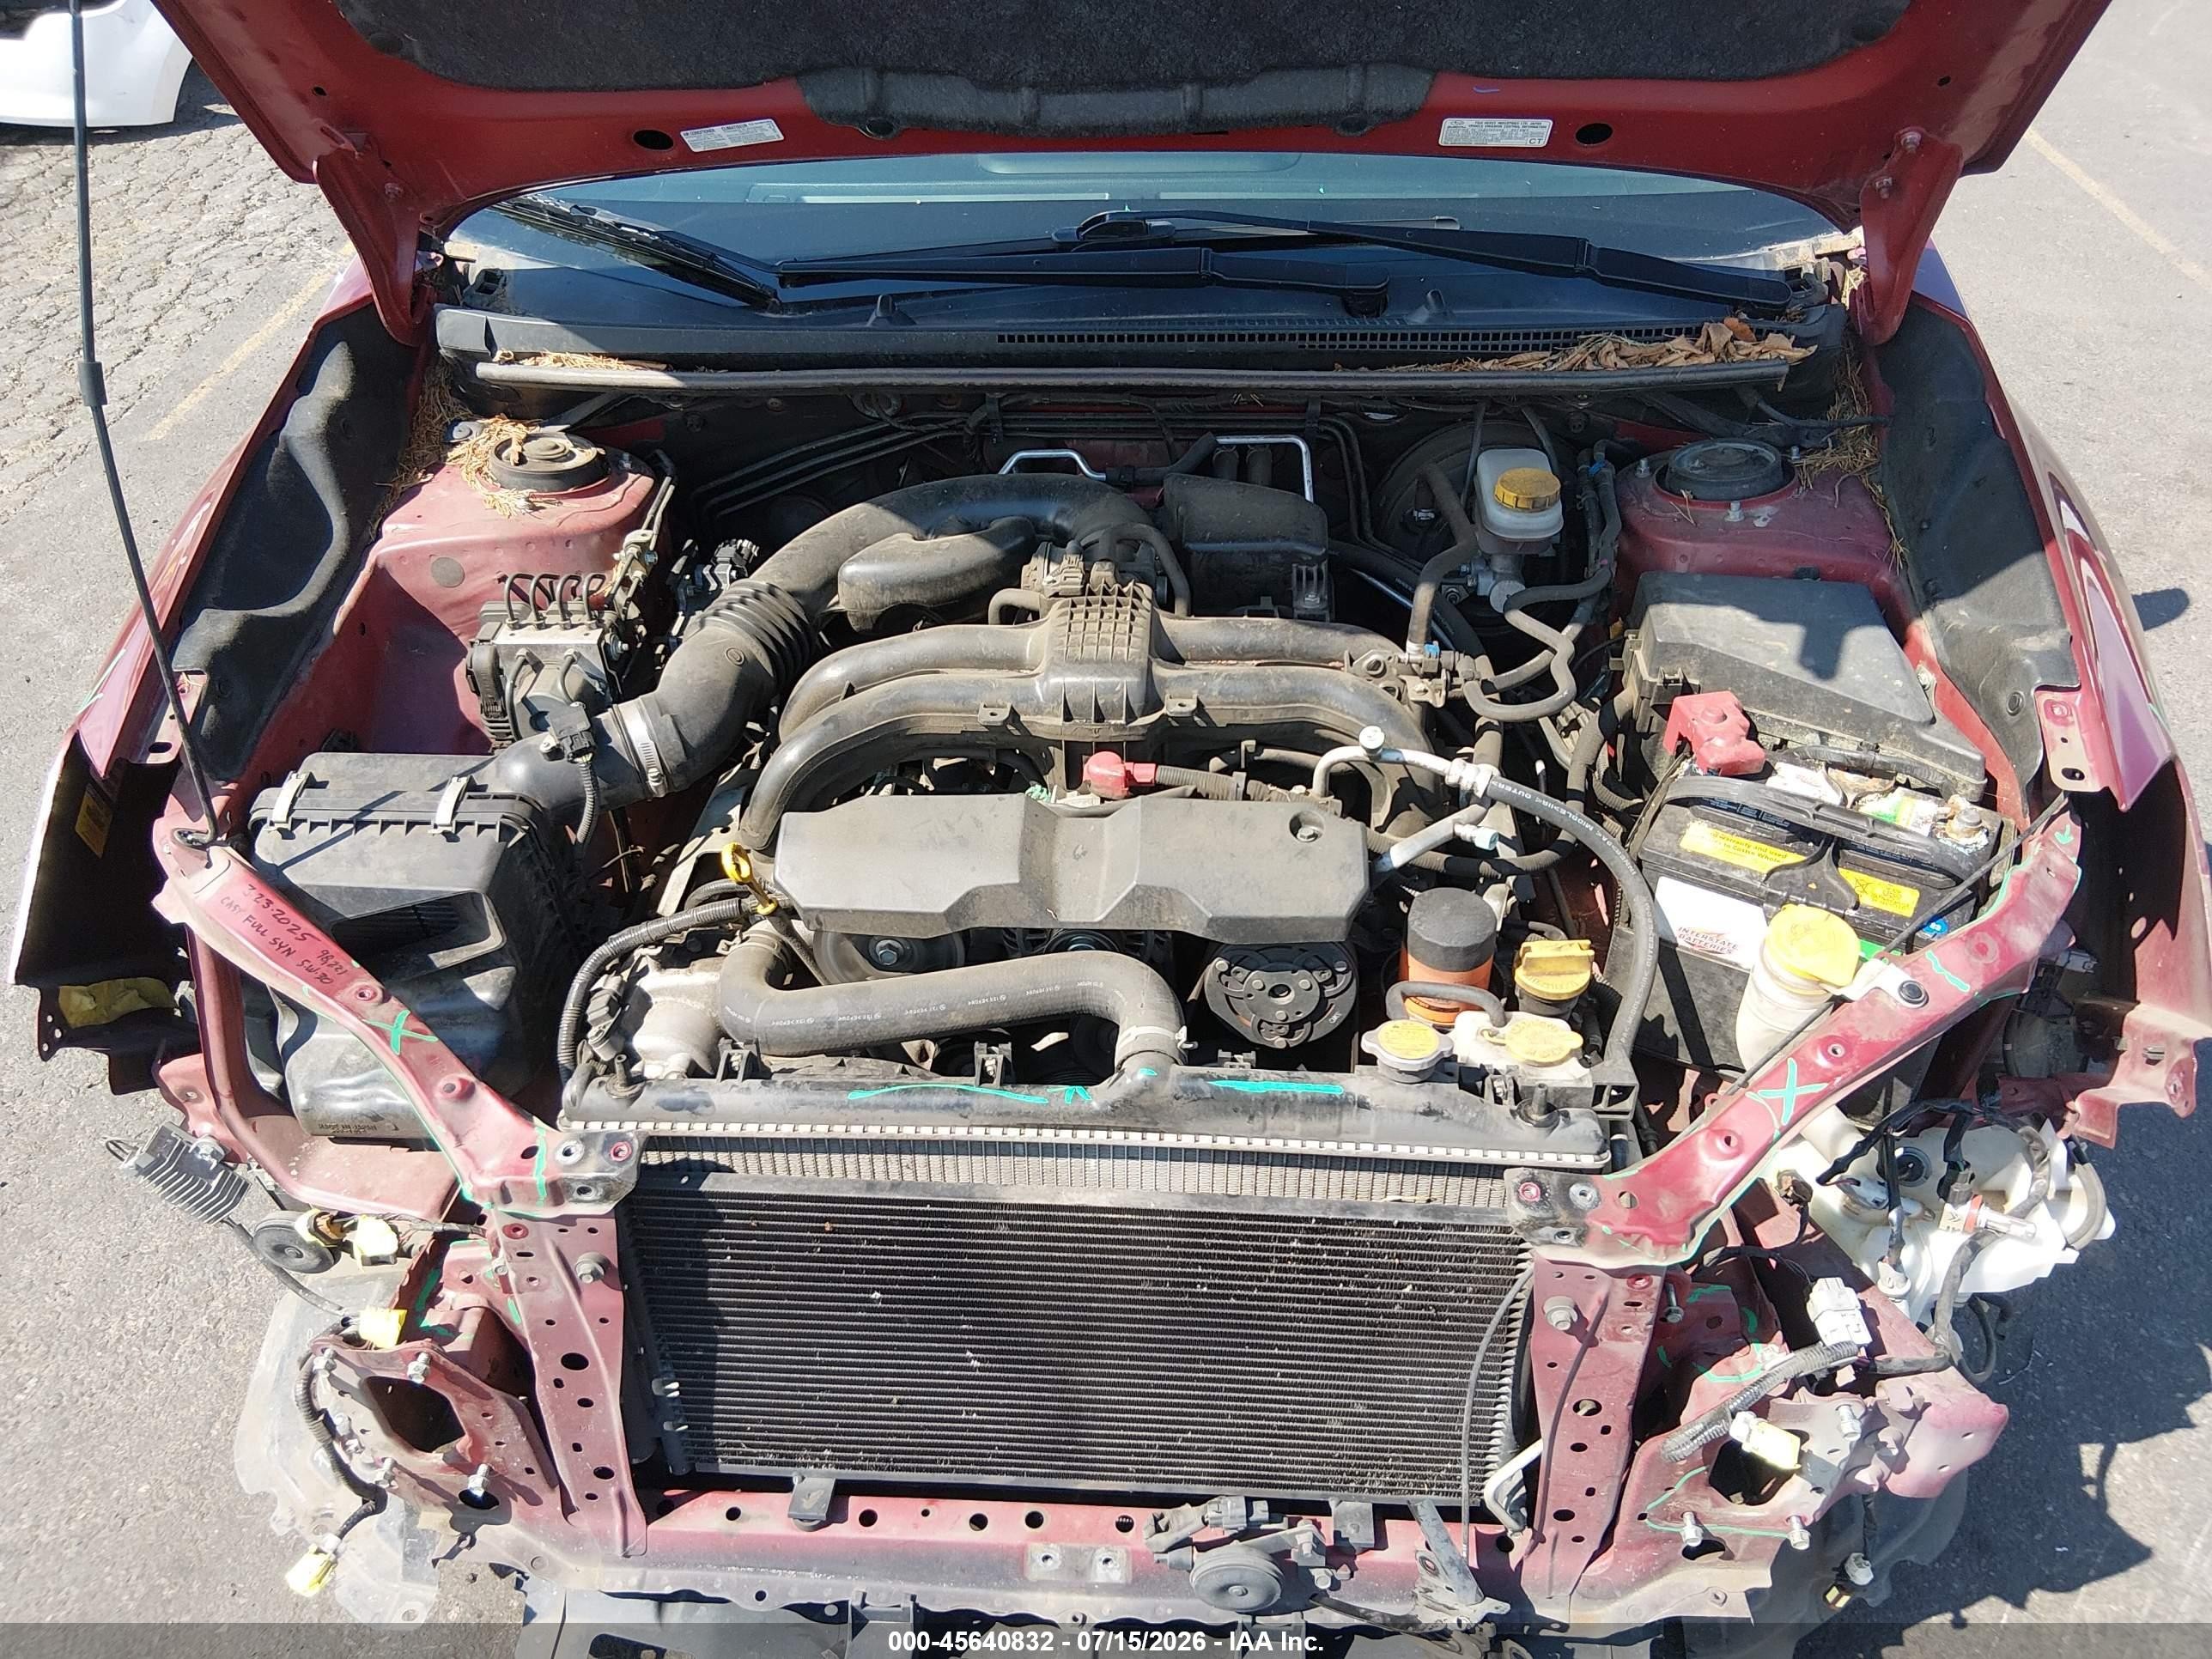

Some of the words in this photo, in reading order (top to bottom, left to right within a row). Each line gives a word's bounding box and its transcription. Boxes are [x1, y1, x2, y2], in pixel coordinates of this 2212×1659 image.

[242, 915, 269, 938] FULL
[269, 937, 296, 957] SYN
[1678, 927, 1739, 950] INTERSTATE
[1678, 933, 1733, 955] BATTERIES
